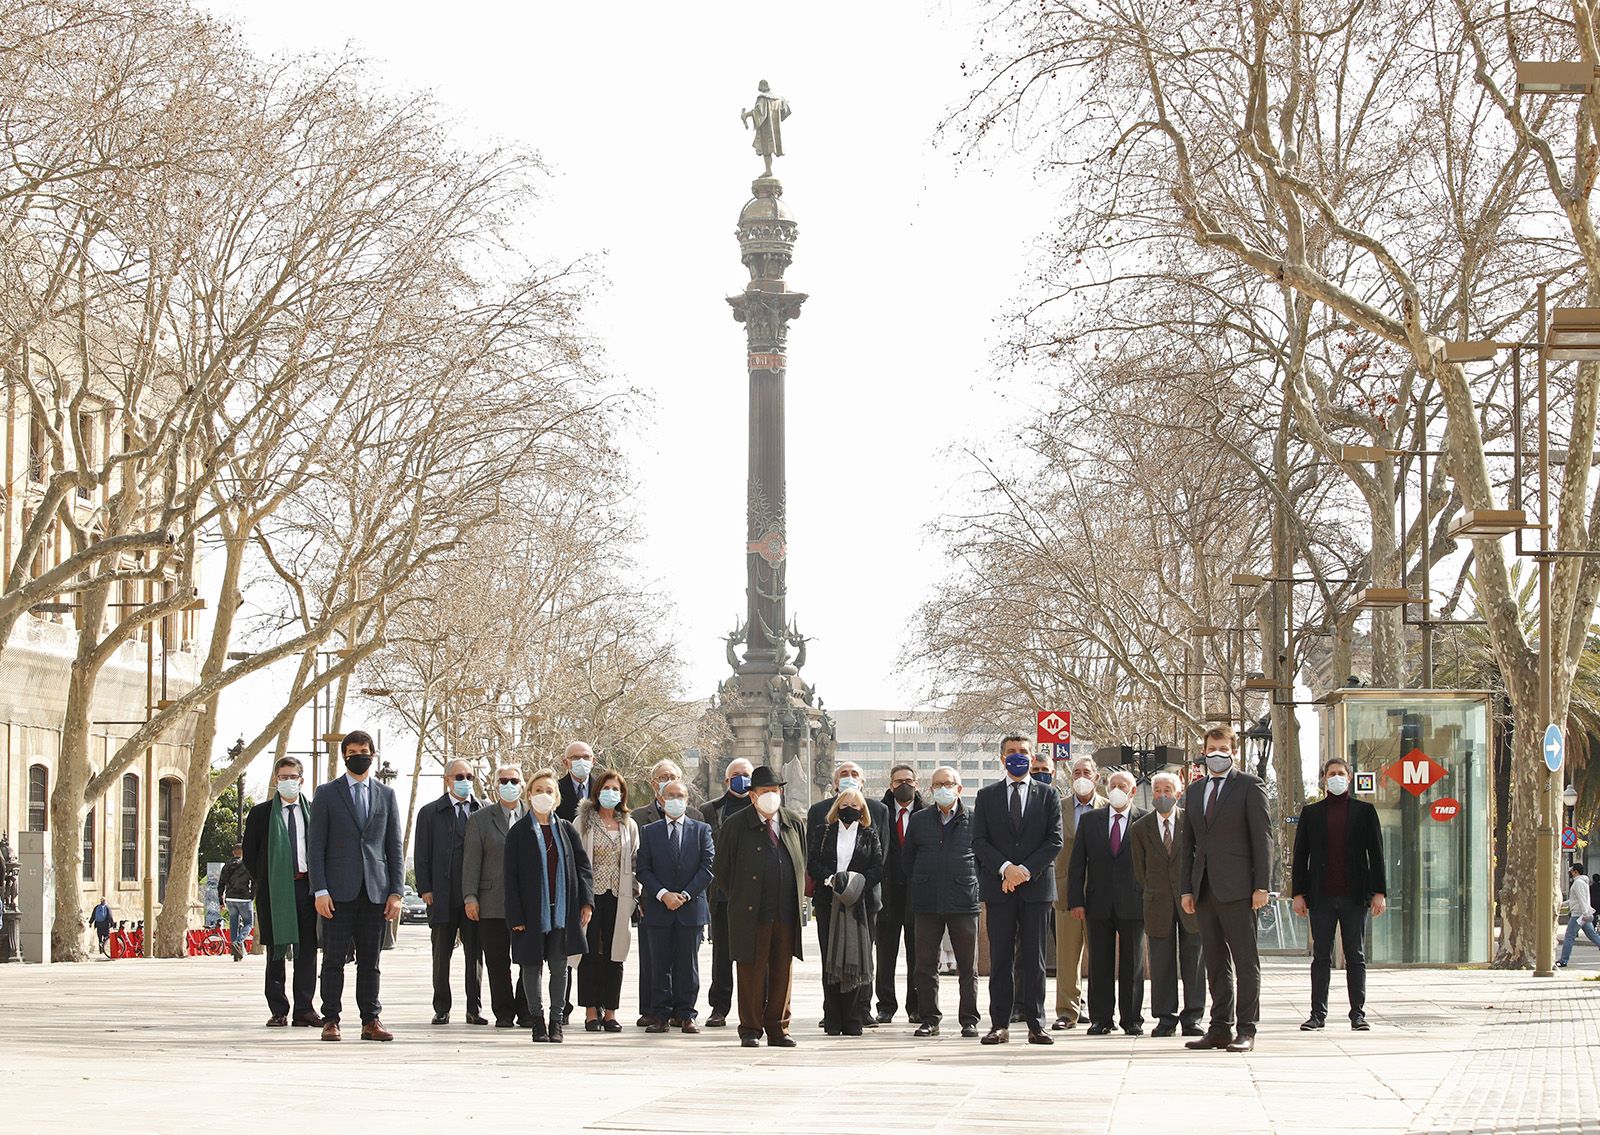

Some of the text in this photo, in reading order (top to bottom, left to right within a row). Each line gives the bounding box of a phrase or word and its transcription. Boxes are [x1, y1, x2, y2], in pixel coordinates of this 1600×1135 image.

[1047, 719, 1059, 729] M
[1403, 761, 1429, 784] M
[1435, 806, 1456, 814] TMB
